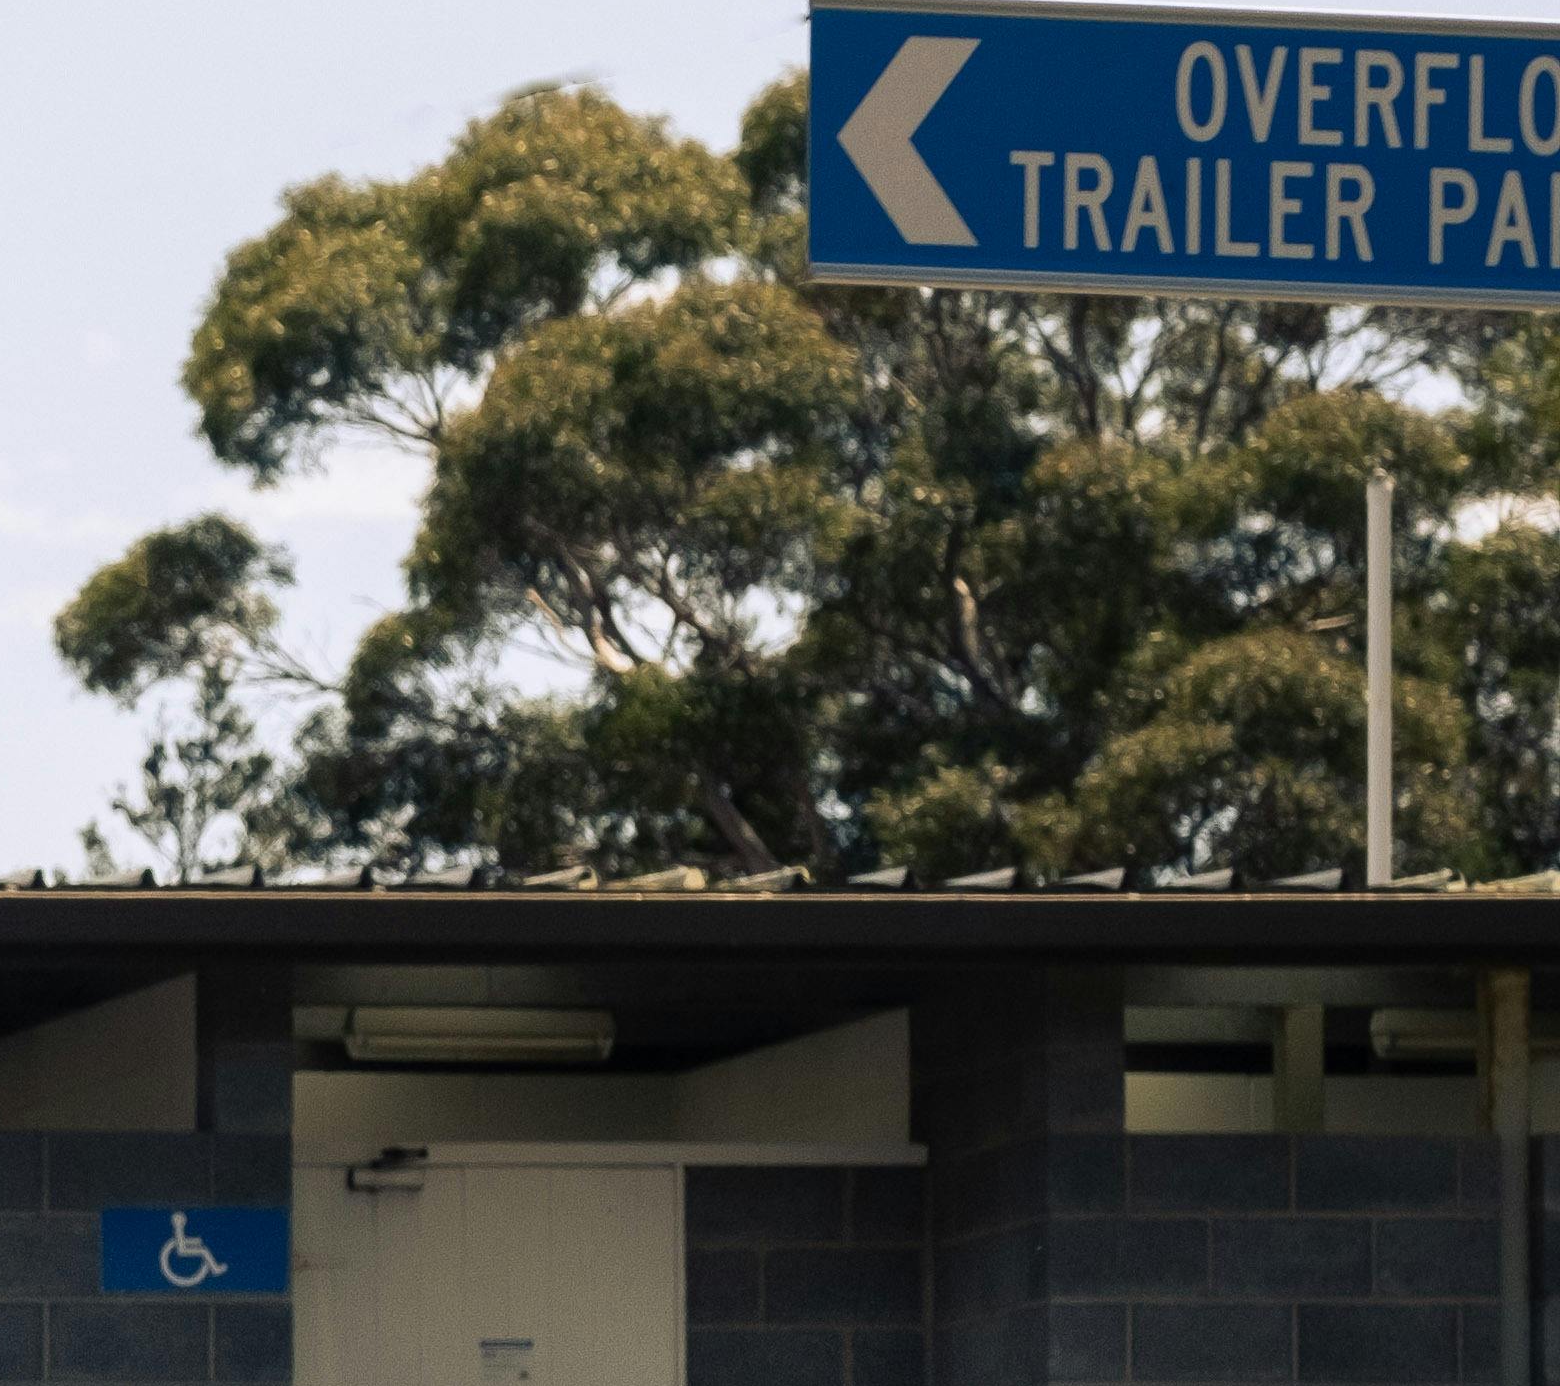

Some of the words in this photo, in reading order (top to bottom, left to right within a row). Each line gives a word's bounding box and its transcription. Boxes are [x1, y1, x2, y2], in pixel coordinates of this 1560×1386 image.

[1175, 40, 1560, 156] OVERFLO
[1008, 149, 1376, 263] TRAILER
[1428, 166, 1560, 269] PA
